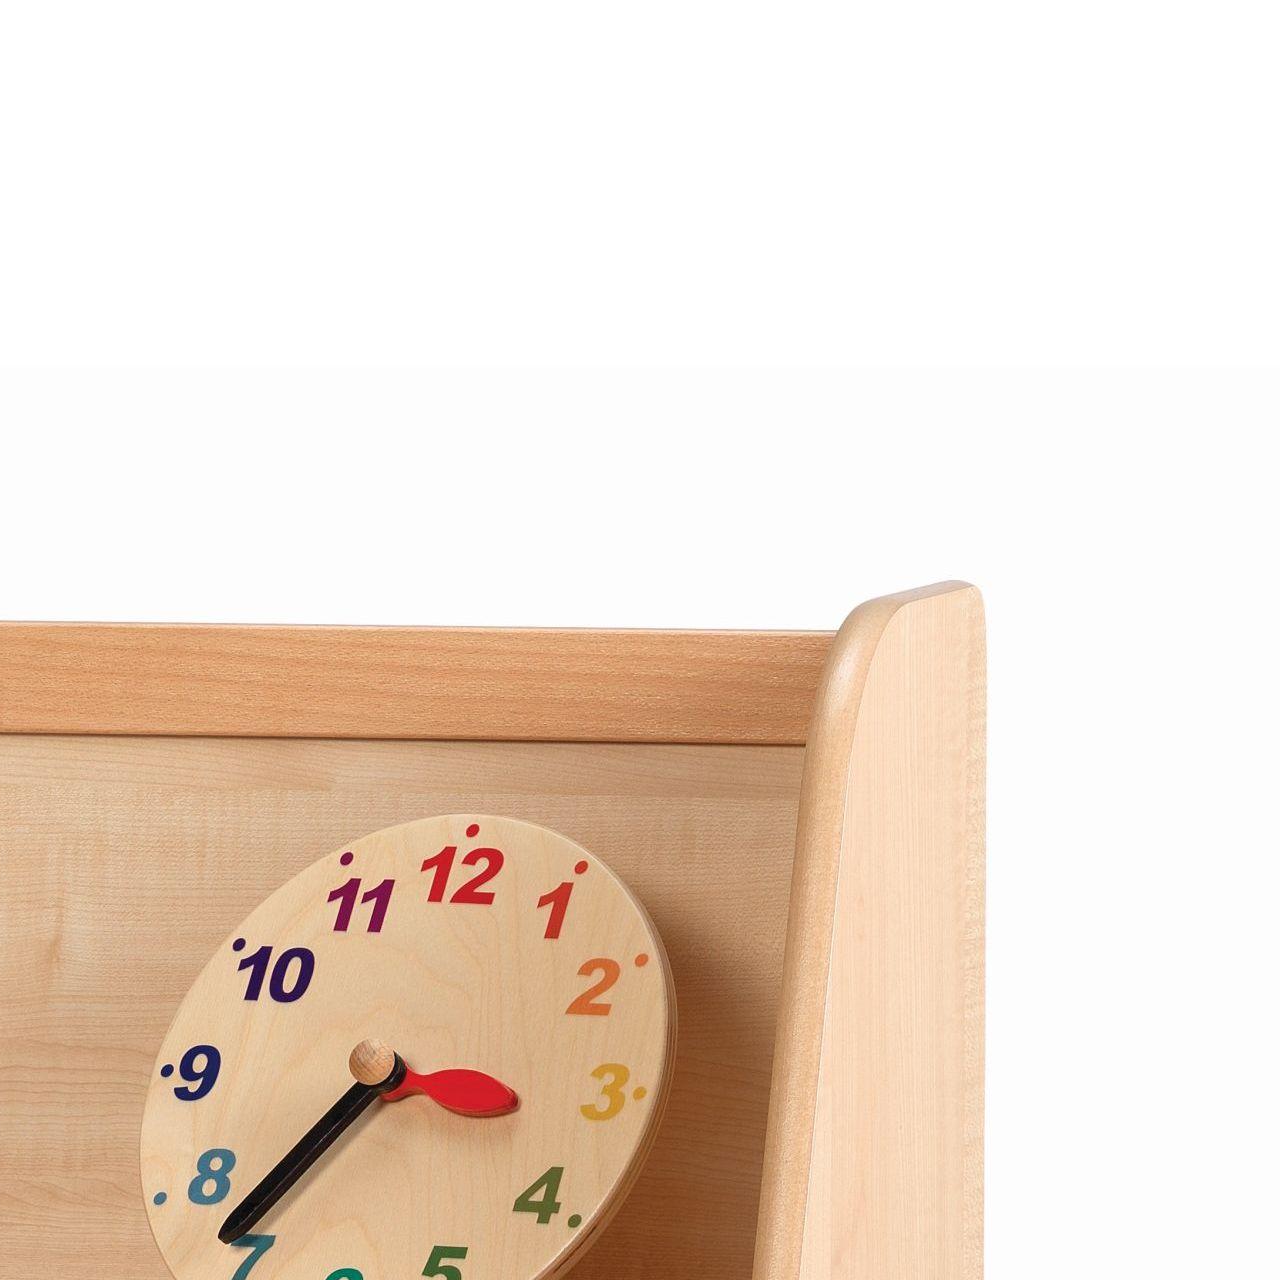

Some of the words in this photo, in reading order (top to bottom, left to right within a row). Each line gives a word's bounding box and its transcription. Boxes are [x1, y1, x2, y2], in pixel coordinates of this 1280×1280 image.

[420, 845, 505, 906] 12
[326, 877, 396, 934] 11
[536, 881, 575, 940] 1
[236, 944, 316, 1004] 10
[565, 957, 621, 1017] 2
[173, 1044, 222, 1102] 9
[580, 1062, 630, 1122] 3
[187, 1148, 237, 1206] 8
[511, 1166, 565, 1225] 4
